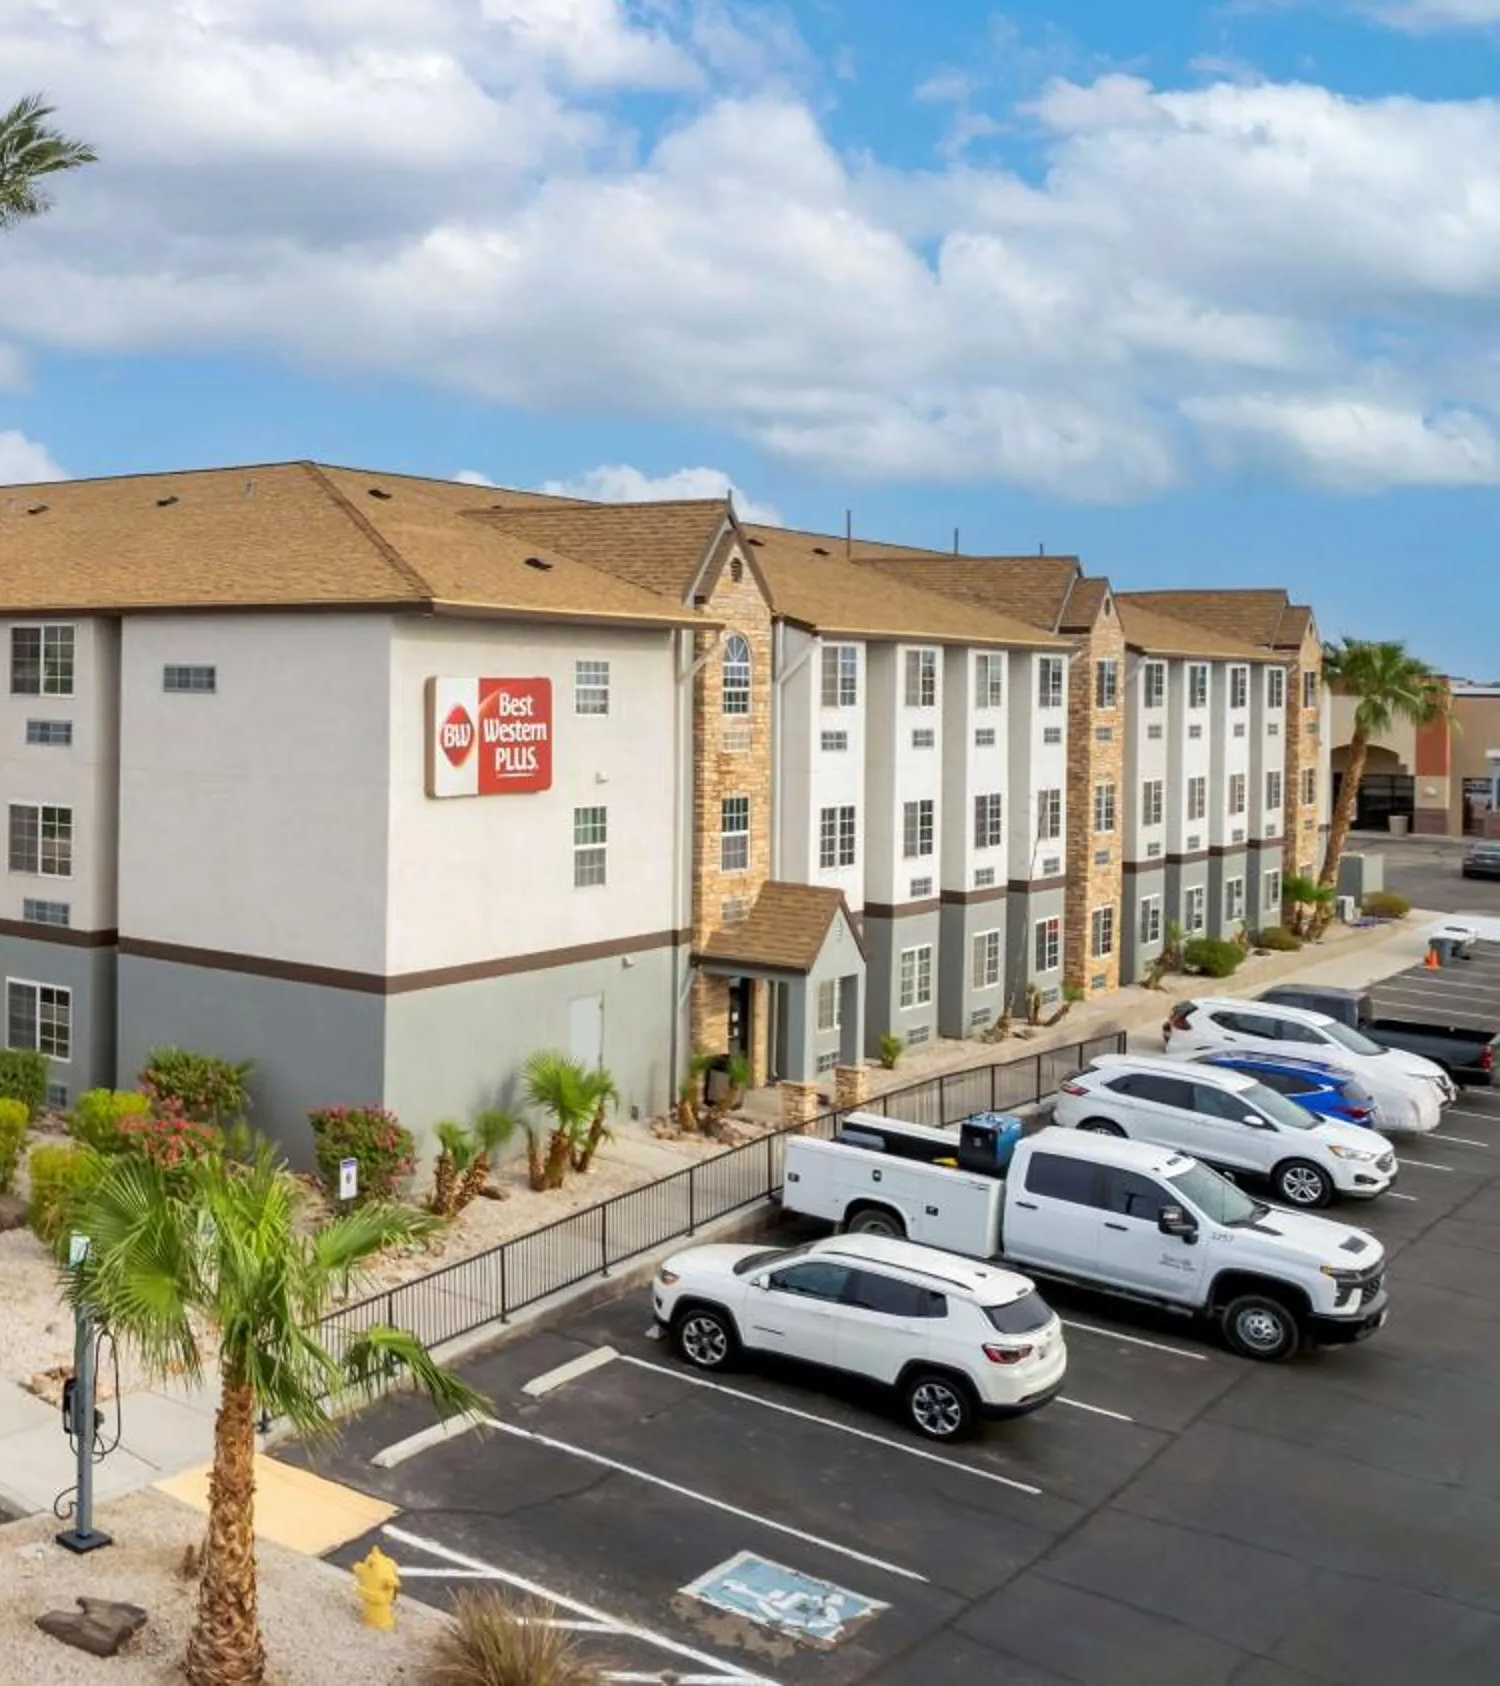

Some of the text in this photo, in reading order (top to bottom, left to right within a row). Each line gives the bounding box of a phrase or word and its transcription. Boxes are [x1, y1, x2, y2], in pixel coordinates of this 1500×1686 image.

[499, 692, 533, 716] Best
[443, 724, 471, 747] BW
[483, 719, 547, 742] Western
